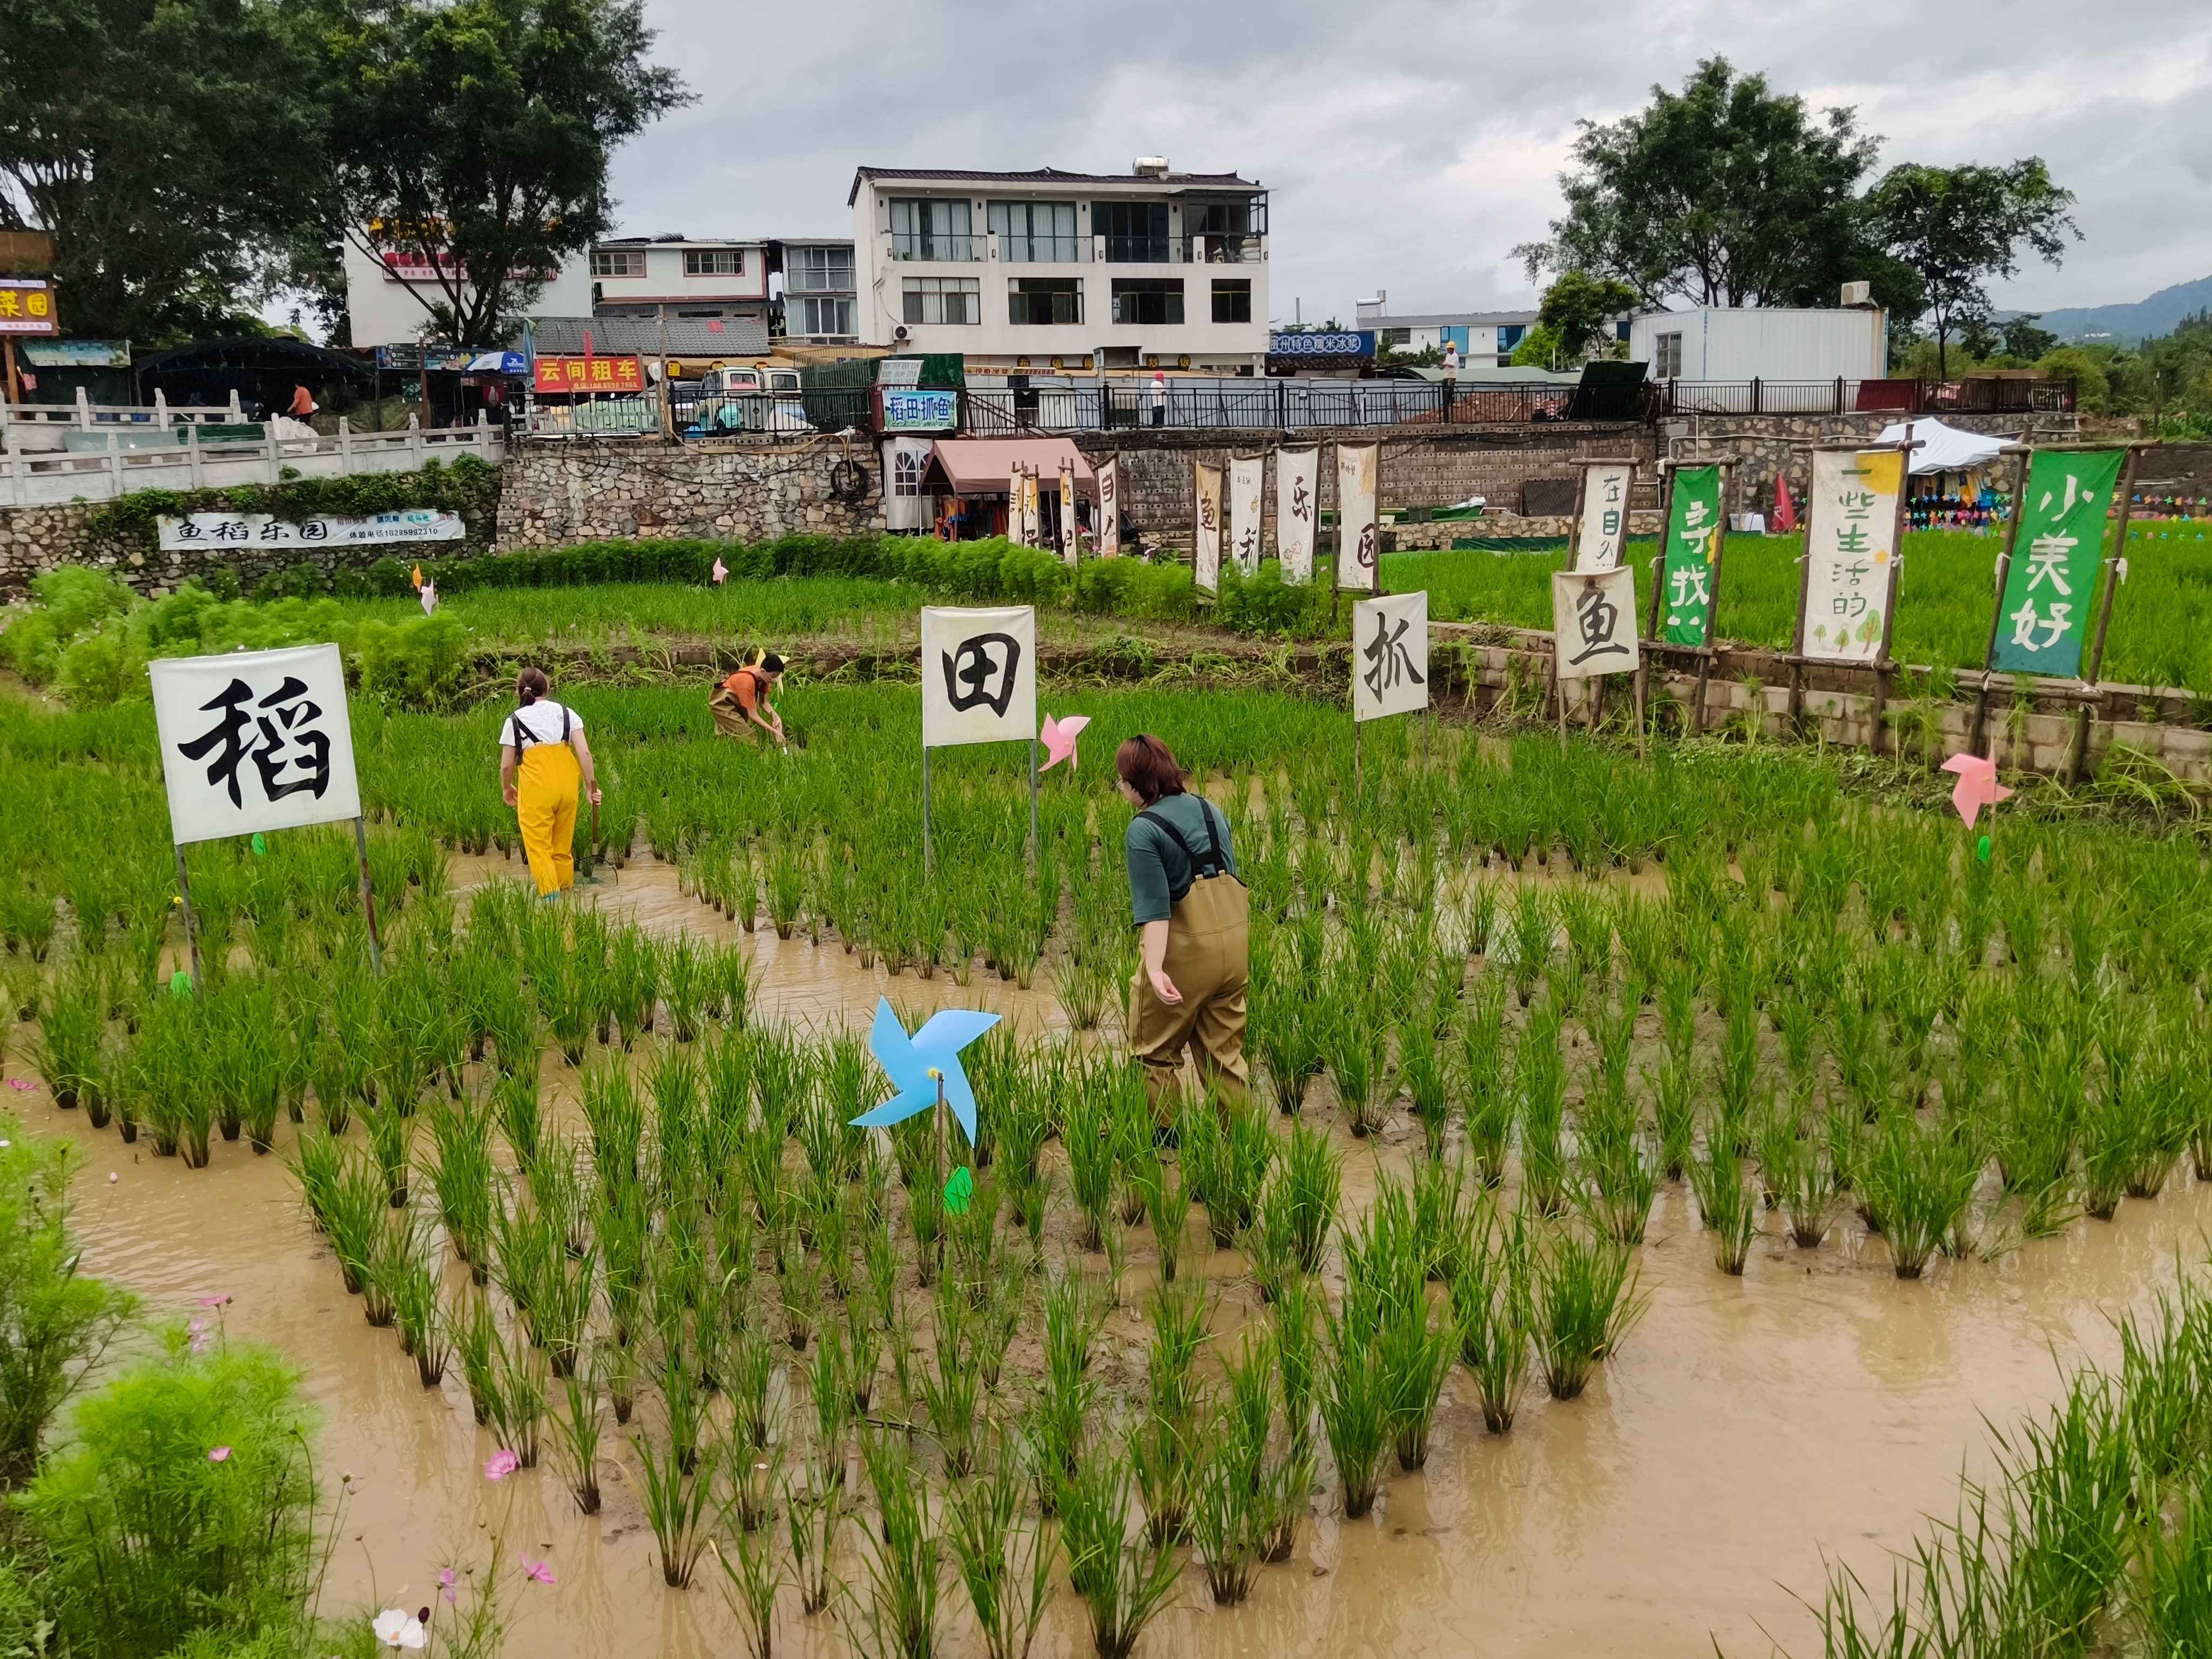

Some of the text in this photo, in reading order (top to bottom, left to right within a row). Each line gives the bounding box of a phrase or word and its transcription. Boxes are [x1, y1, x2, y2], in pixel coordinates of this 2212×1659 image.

[540, 360, 637, 381] 云间租车
[890, 396, 950, 421] 稻田抓鱼
[173, 520, 328, 543] 鱼稻乐园
[1201, 489, 1217, 532] 鱼
[1831, 468, 1876, 617] 一些生活的
[2010, 474, 2094, 652] 小美好
[1363, 611, 1425, 705] 抓
[1568, 578, 1630, 666] 鱼
[942, 632, 1021, 718] 田
[177, 676, 331, 810] 稻
